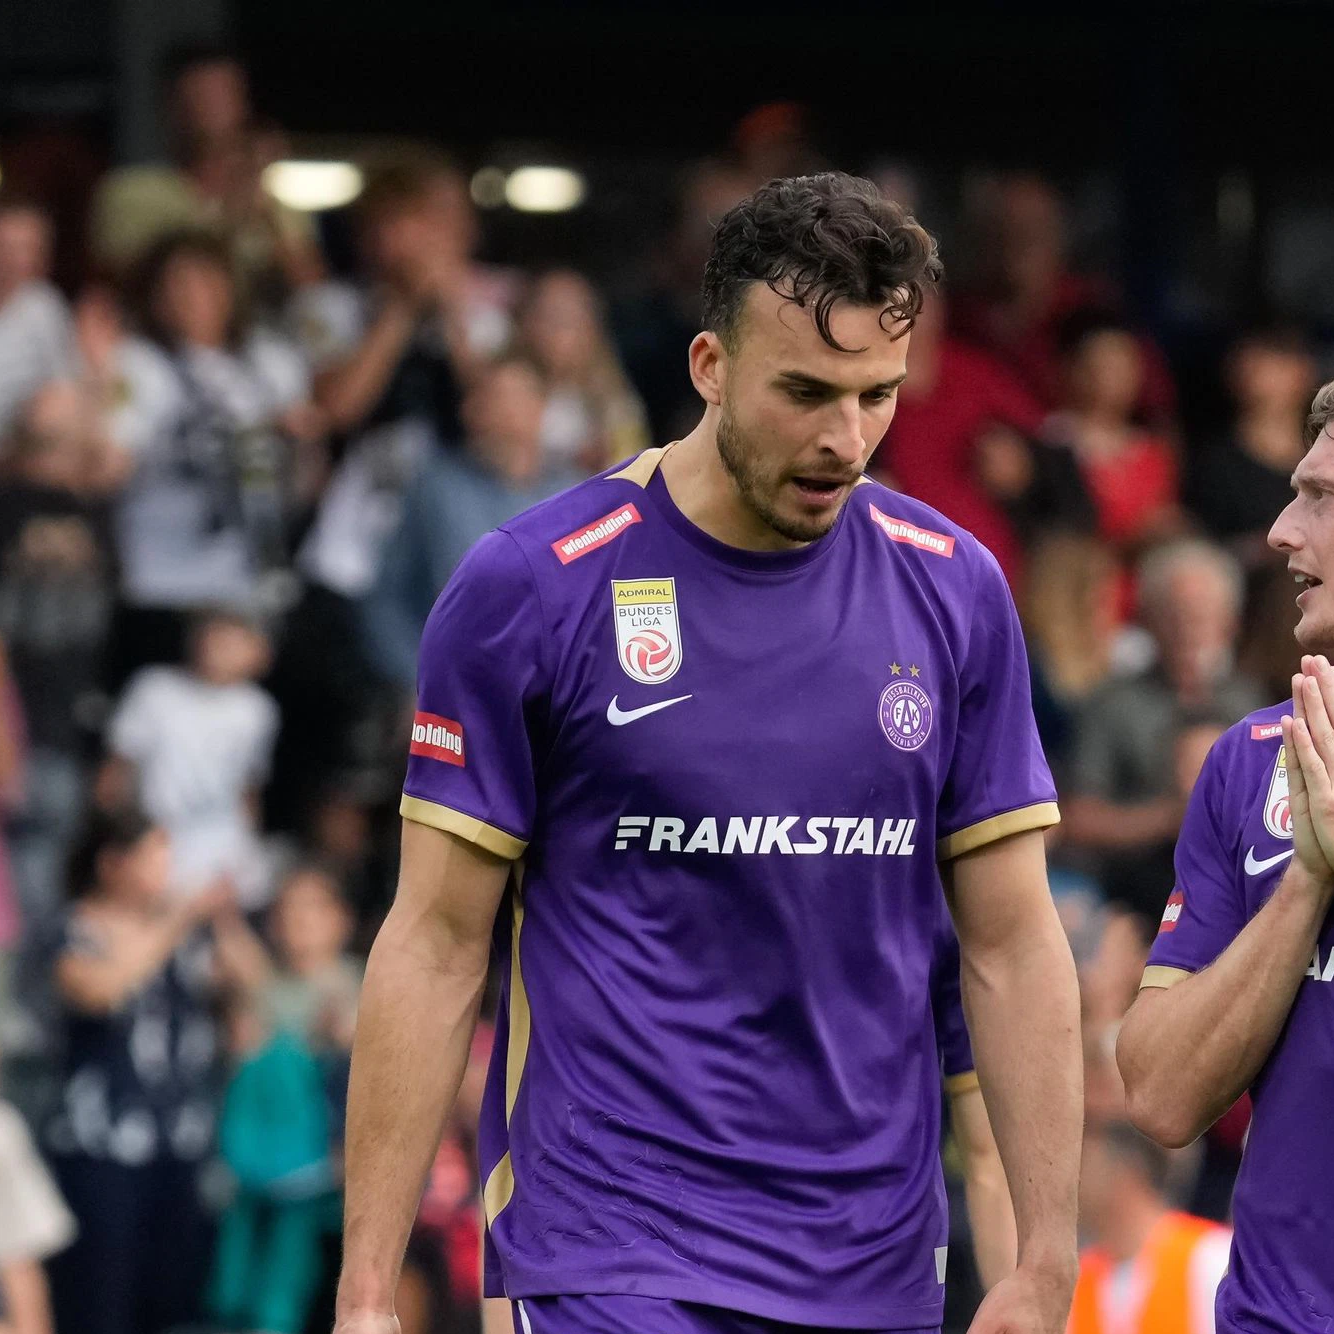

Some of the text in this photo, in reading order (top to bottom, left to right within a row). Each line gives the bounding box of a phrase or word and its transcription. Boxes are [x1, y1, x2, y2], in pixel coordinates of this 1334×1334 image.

[617, 588, 671, 598] ADMIRAL
[618, 606, 672, 617] BUNDES
[631, 617, 662, 627] LIGA
[614, 816, 916, 856] FRANKSTAHL
